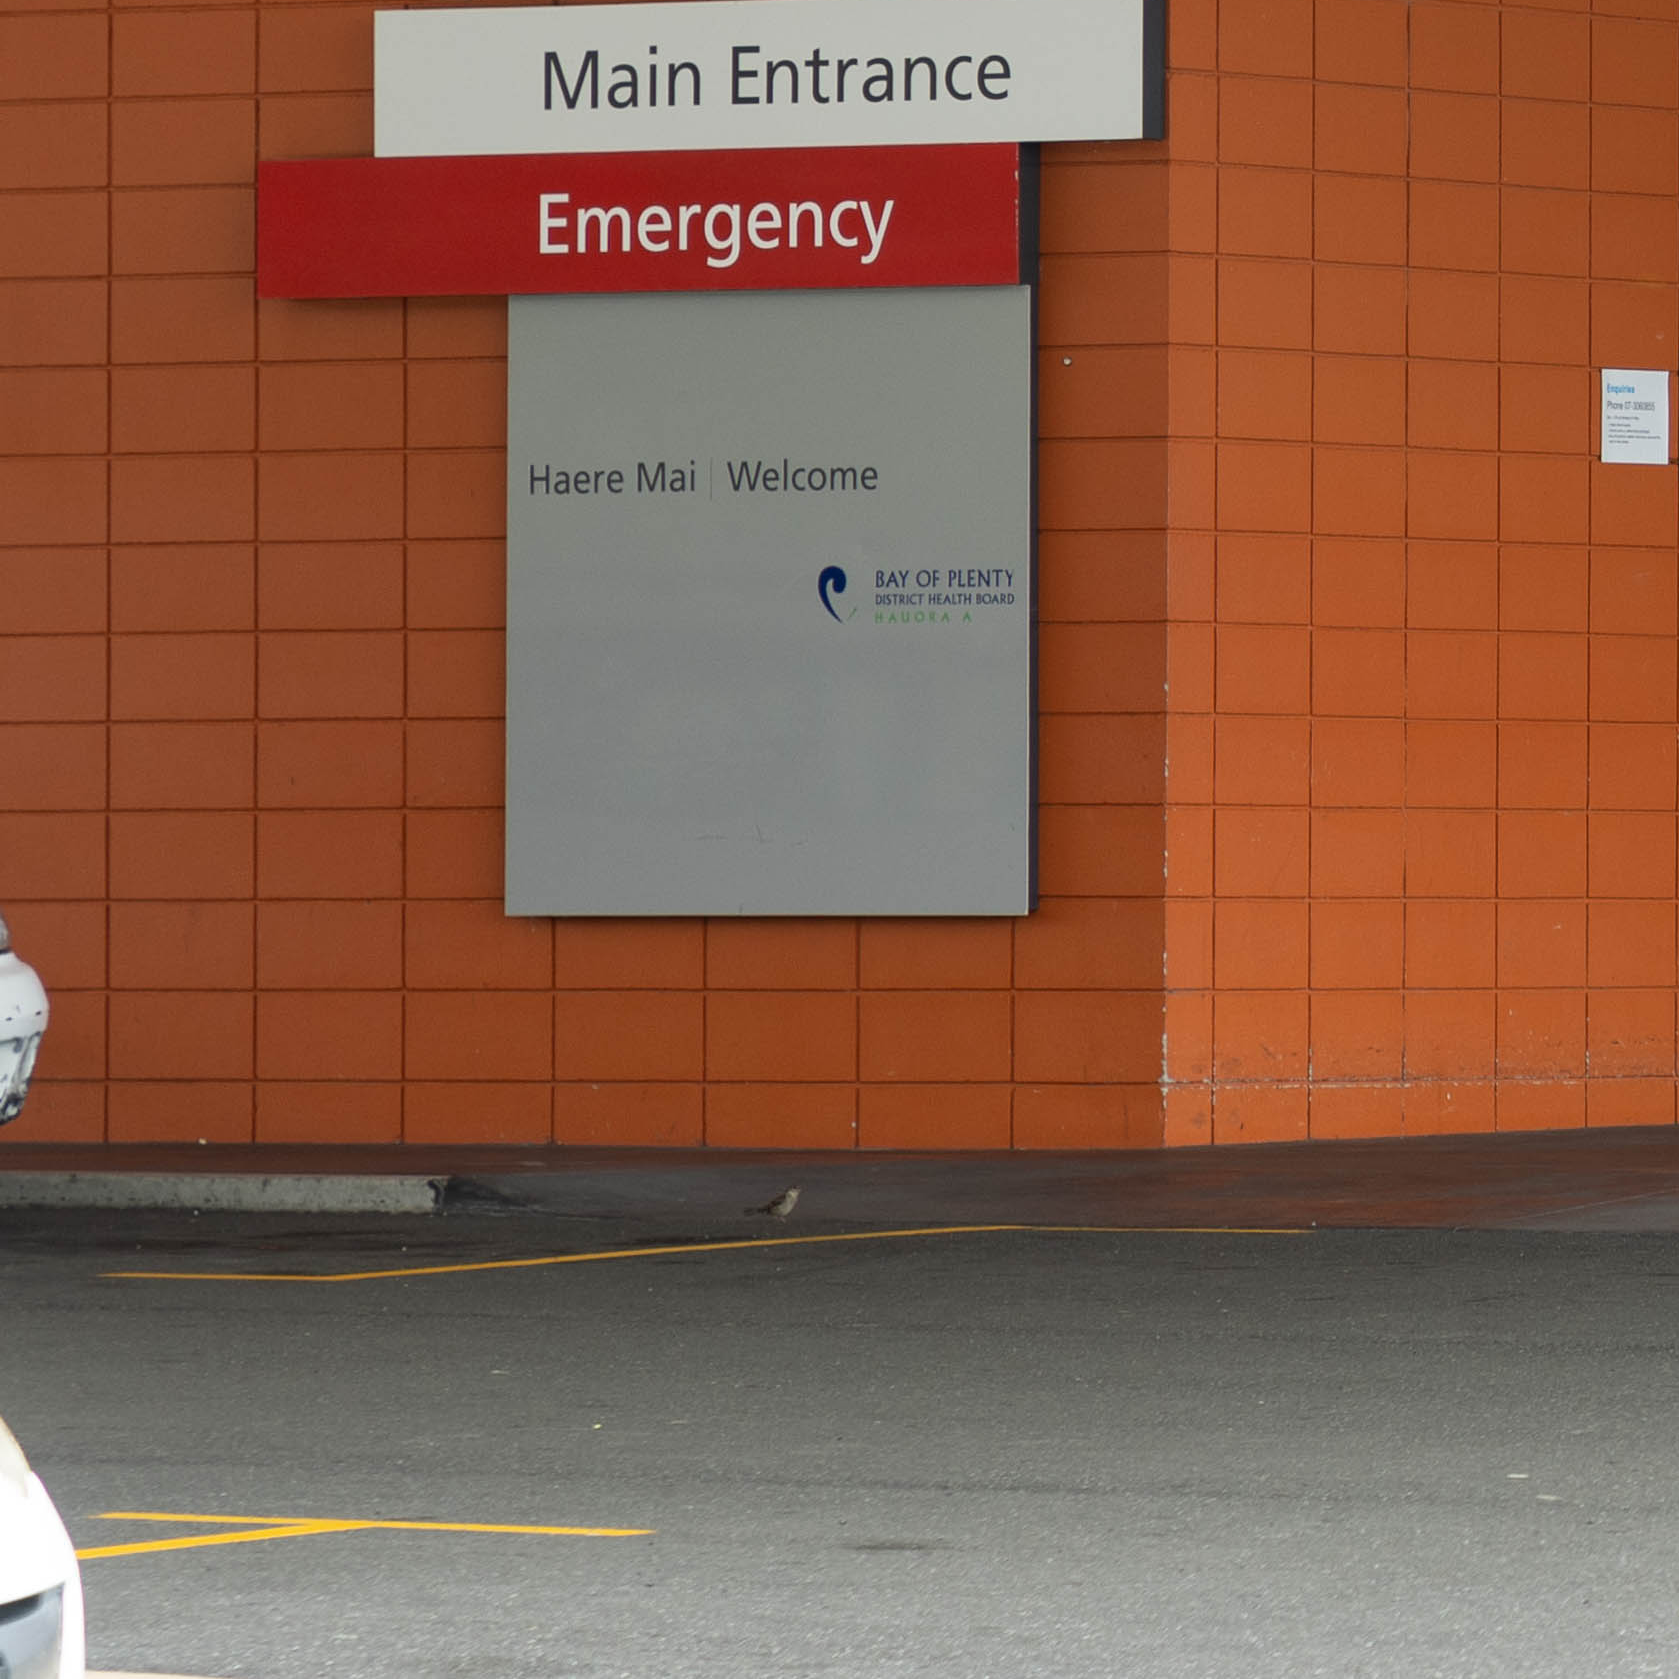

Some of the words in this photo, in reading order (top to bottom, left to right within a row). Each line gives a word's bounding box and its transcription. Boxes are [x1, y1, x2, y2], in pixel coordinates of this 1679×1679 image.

[545, 46, 700, 110] Main
[732, 46, 1010, 104] Entrance
[540, 194, 894, 267] Emergency
[530, 465, 623, 494] Haere
[638, 460, 694, 492] Mai
[727, 459, 877, 491] Welcome
[875, 570, 909, 588] BAY
[916, 570, 939, 587] OF
[949, 569, 1015, 587] PLENTY
[875, 594, 923, 605] DISTRICT
[929, 594, 971, 605] HEALTH
[976, 594, 1015, 605] BOARD
[875, 612, 950, 623] HAUORA
